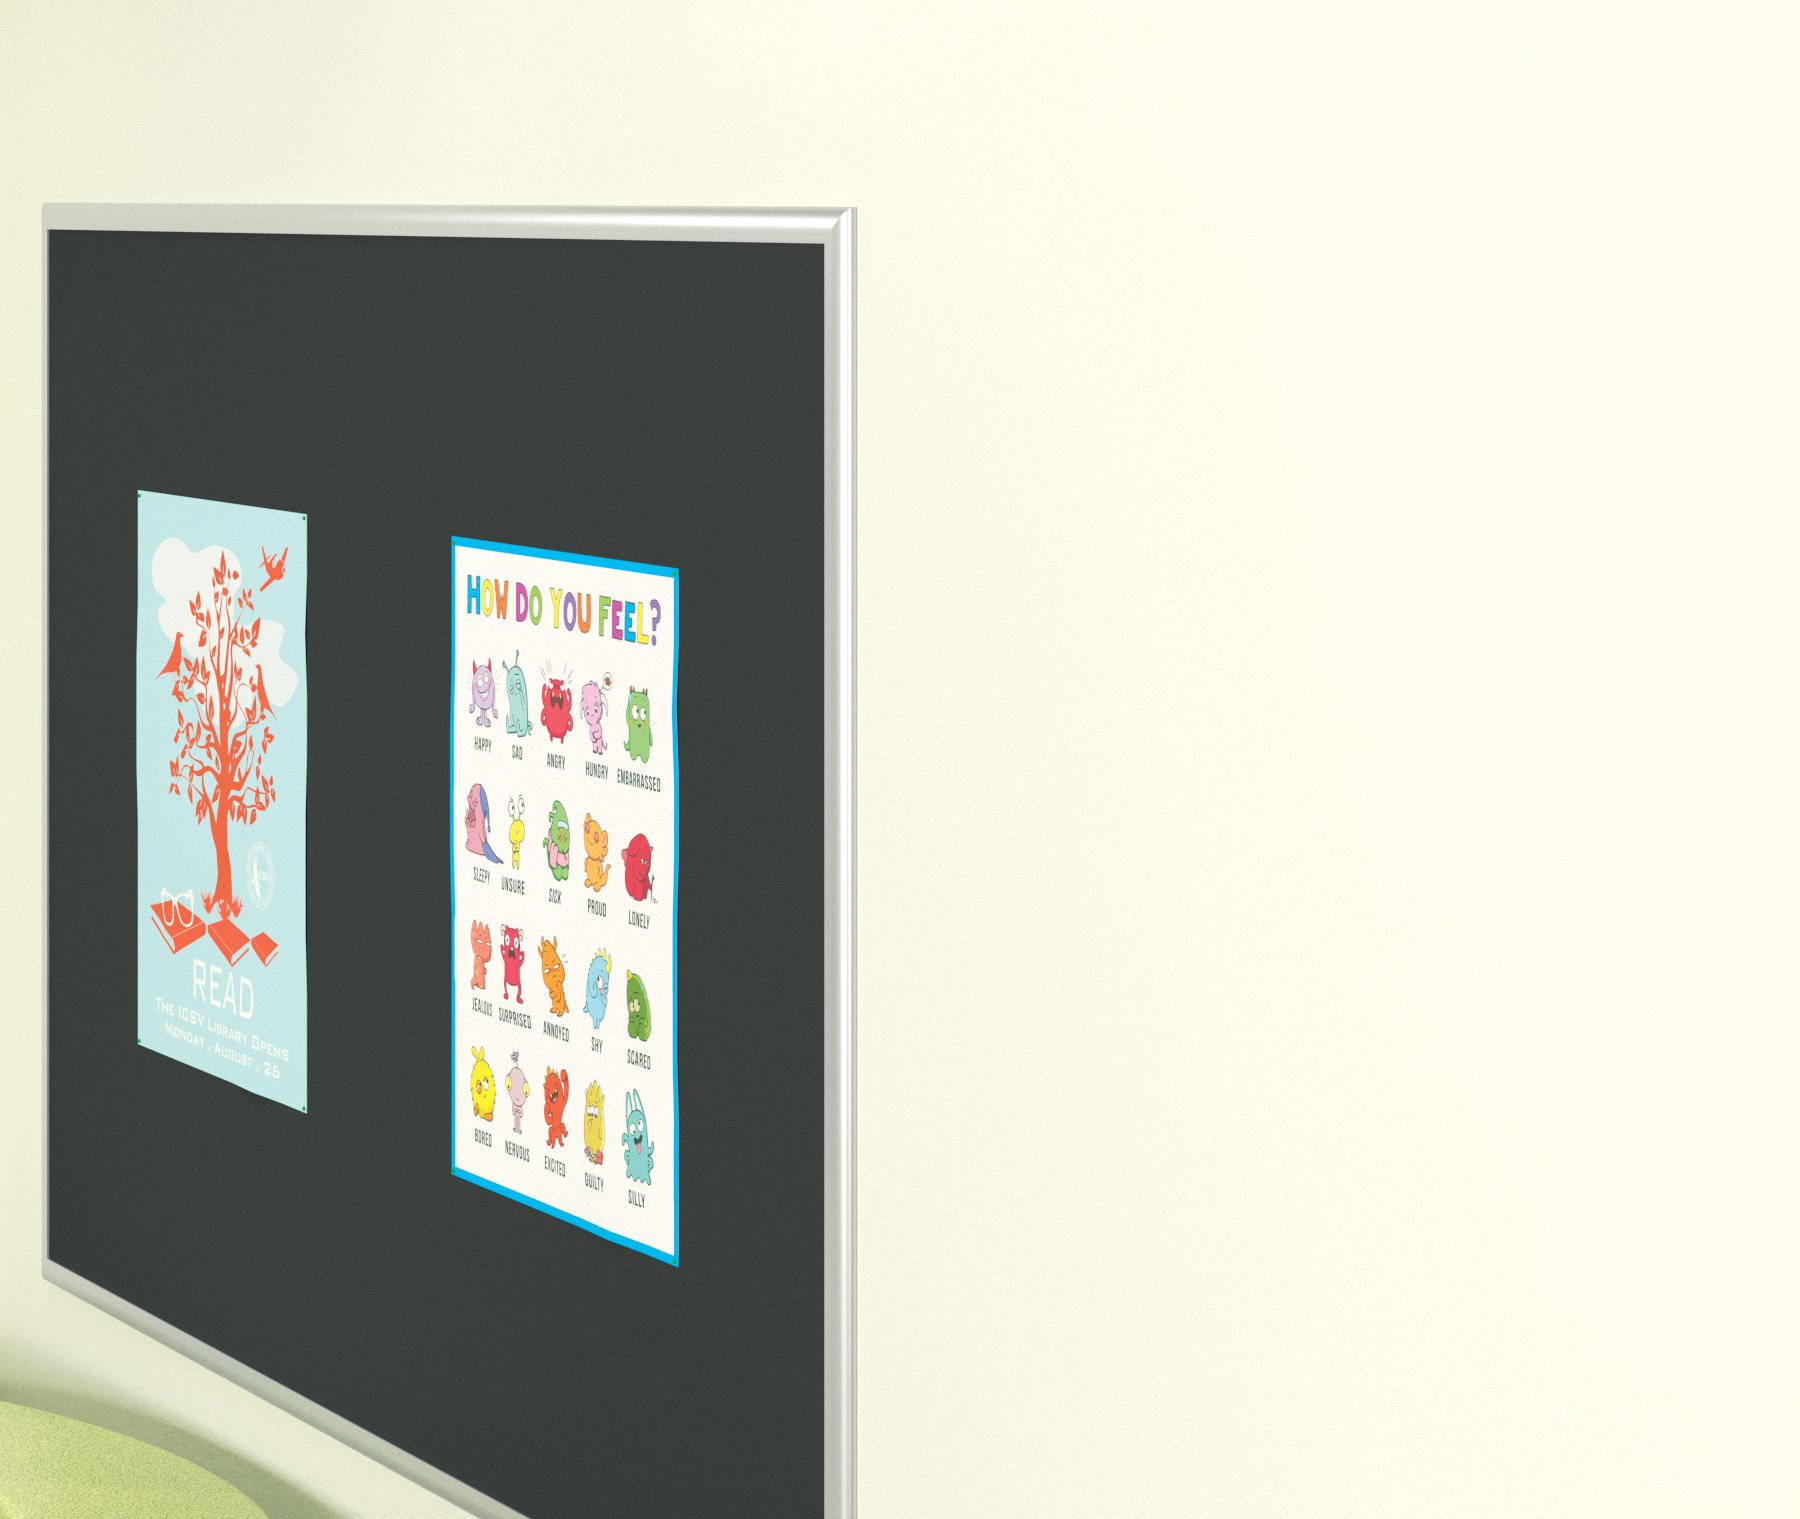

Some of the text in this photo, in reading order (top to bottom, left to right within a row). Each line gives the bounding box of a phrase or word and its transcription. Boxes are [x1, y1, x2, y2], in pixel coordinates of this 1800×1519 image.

[467, 574, 661, 646] HOW DO YOU FEEL?
[474, 736, 492, 754] HAPPY
[512, 744, 523, 760] SAD
[546, 752, 566, 770] ANGRY
[585, 762, 608, 780] HUNGRY
[616, 768, 661, 793] EMBARRASSED
[473, 866, 490, 885] SLEEPY
[502, 876, 526, 896] UNSURE
[548, 888, 562, 905] SICK
[587, 898, 607, 918] PROUD
[628, 910, 650, 930] LONELY
[193, 958, 254, 1020] READ
[472, 996, 493, 1018] JEALOUS
[498, 1007, 532, 1030] SURPRISED
[155, 996, 290, 1062] THE ICSV LIBRARY OPENS
[542, 1021, 570, 1043] ANNOYED
[164, 1020, 206, 1048] MONDAY
[214, 1042, 253, 1068] AUGUST
[263, 1061, 281, 1079] 26
[591, 1036, 603, 1054] SHY
[626, 1048, 651, 1070] SCARED
[474, 1128, 492, 1148] BORED
[504, 1140, 530, 1163] NERVOUS
[544, 1155, 566, 1178] EXCITED
[584, 1172, 604, 1193] GUILTY
[628, 1190, 646, 1209] SILLY
